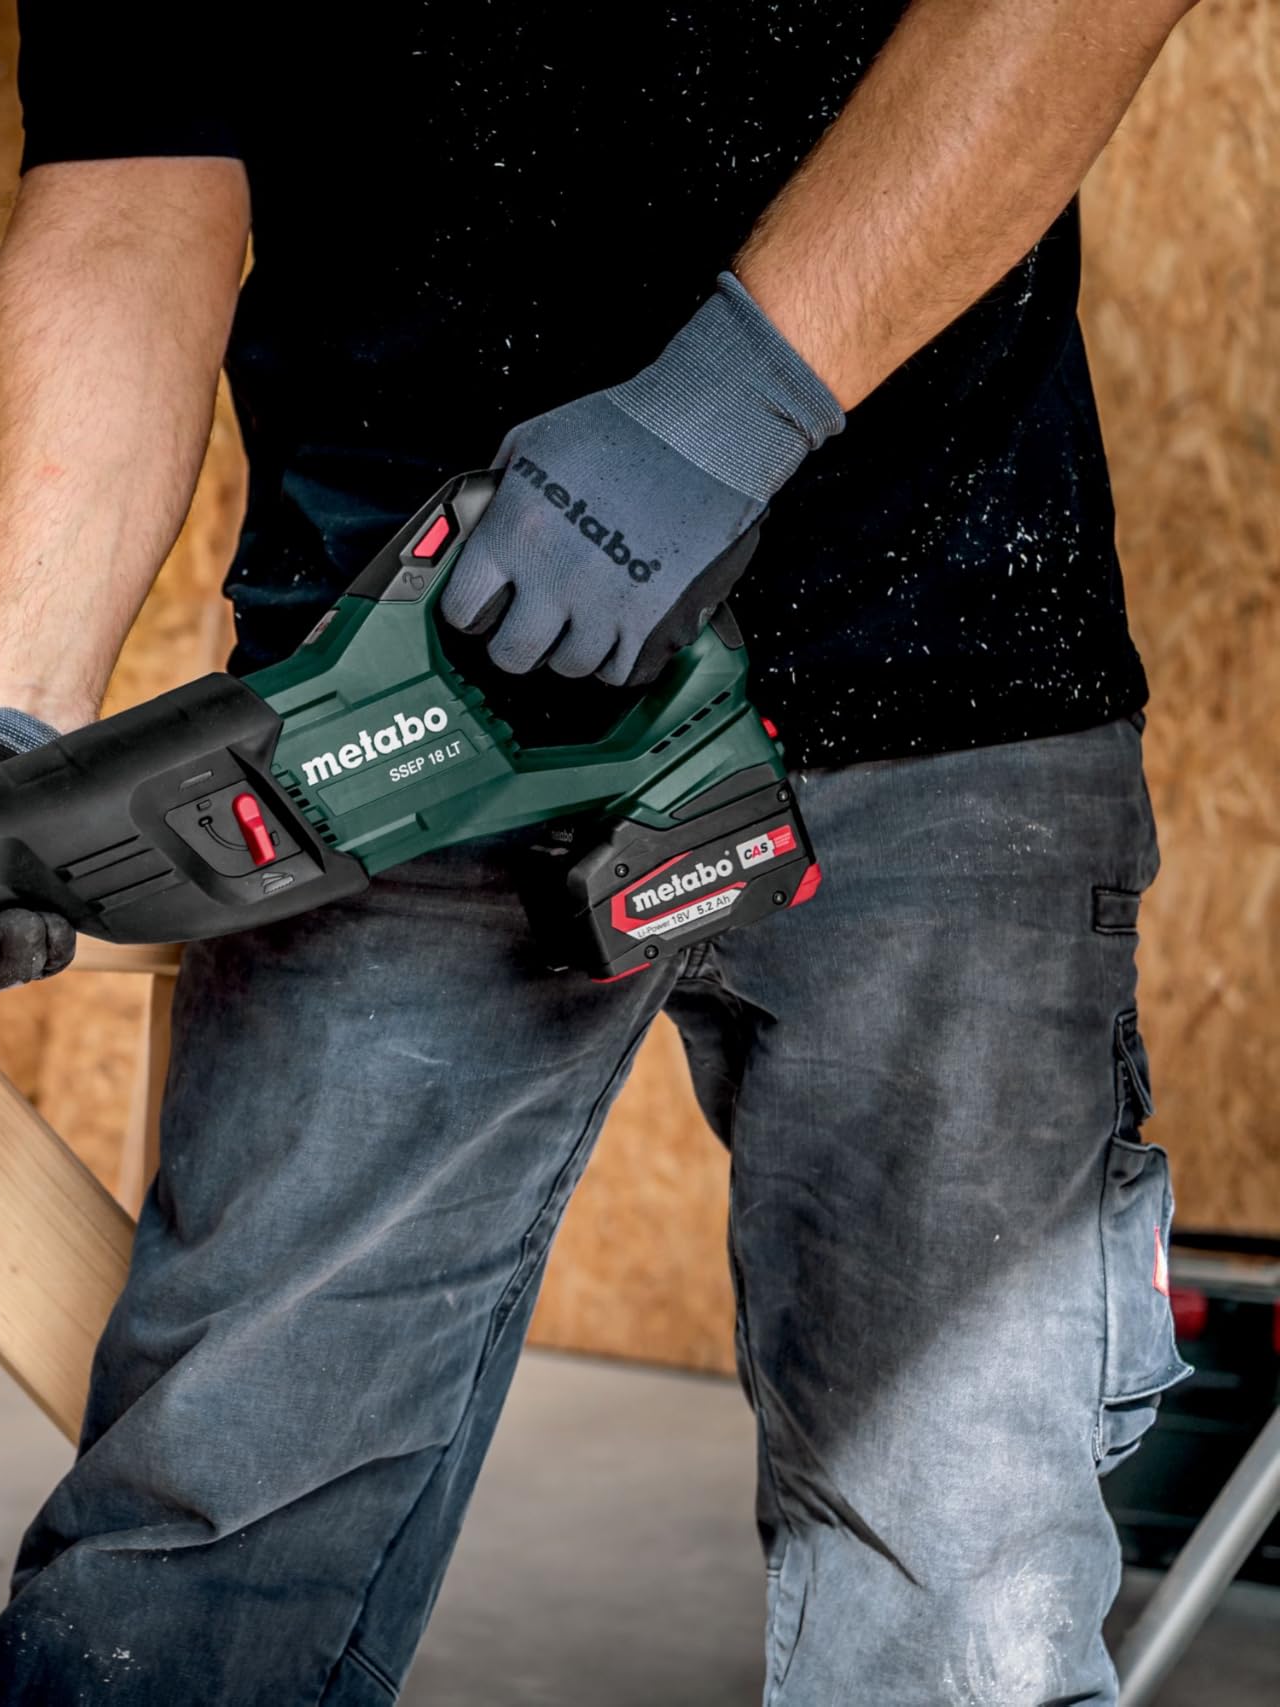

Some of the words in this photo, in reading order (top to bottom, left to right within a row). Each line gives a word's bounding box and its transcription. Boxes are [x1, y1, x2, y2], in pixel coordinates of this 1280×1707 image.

[512, 456, 653, 583] metabo
[301, 707, 448, 786] metabo
[389, 757, 425, 782] SSEP
[428, 750, 445, 766] 18
[446, 740, 462, 758] LT
[744, 842, 768, 860] CAS
[632, 858, 734, 913] metabo
[671, 910, 691, 925] 18V
[696, 901, 714, 915] 5.2
[716, 895, 731, 908] Ah
